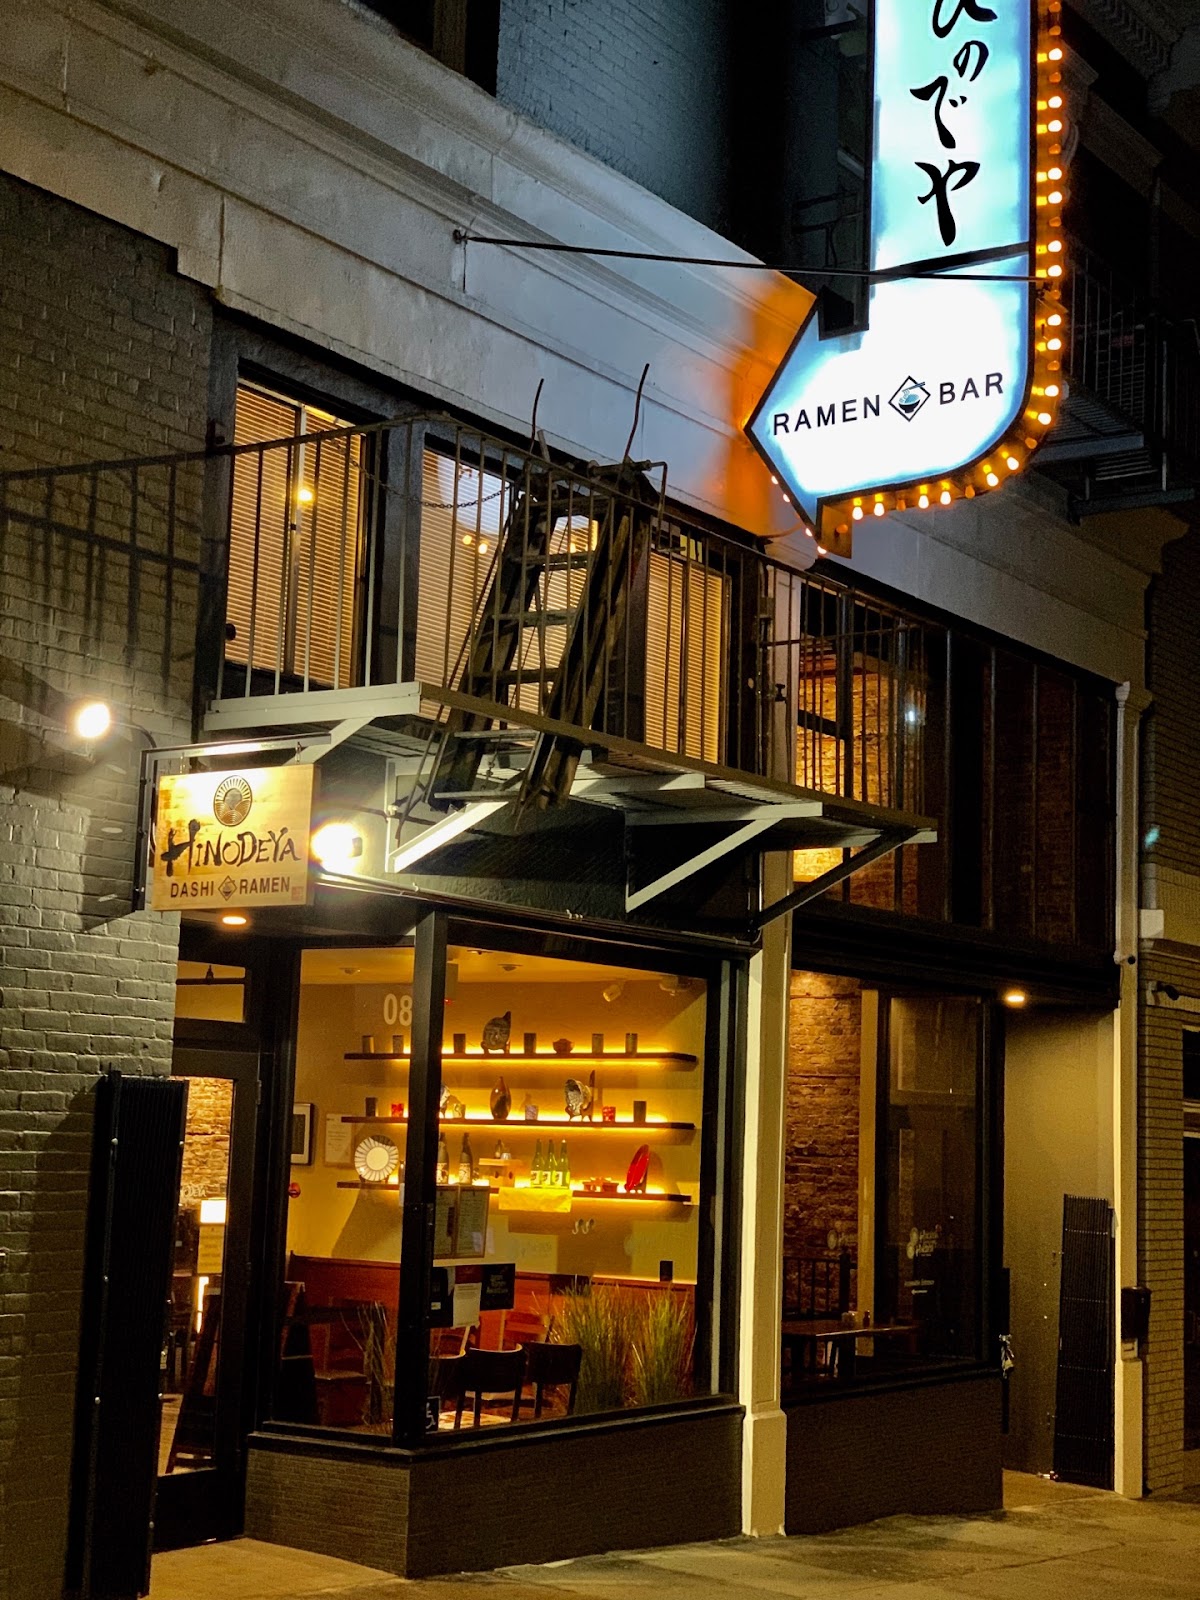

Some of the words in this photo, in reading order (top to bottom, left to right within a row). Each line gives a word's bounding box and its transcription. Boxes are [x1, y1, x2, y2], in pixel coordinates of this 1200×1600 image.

[773, 394, 881, 436] RAMEN
[939, 372, 1004, 405] BAR
[170, 880, 215, 898] DASHI
[239, 876, 291, 895] RAMEN
